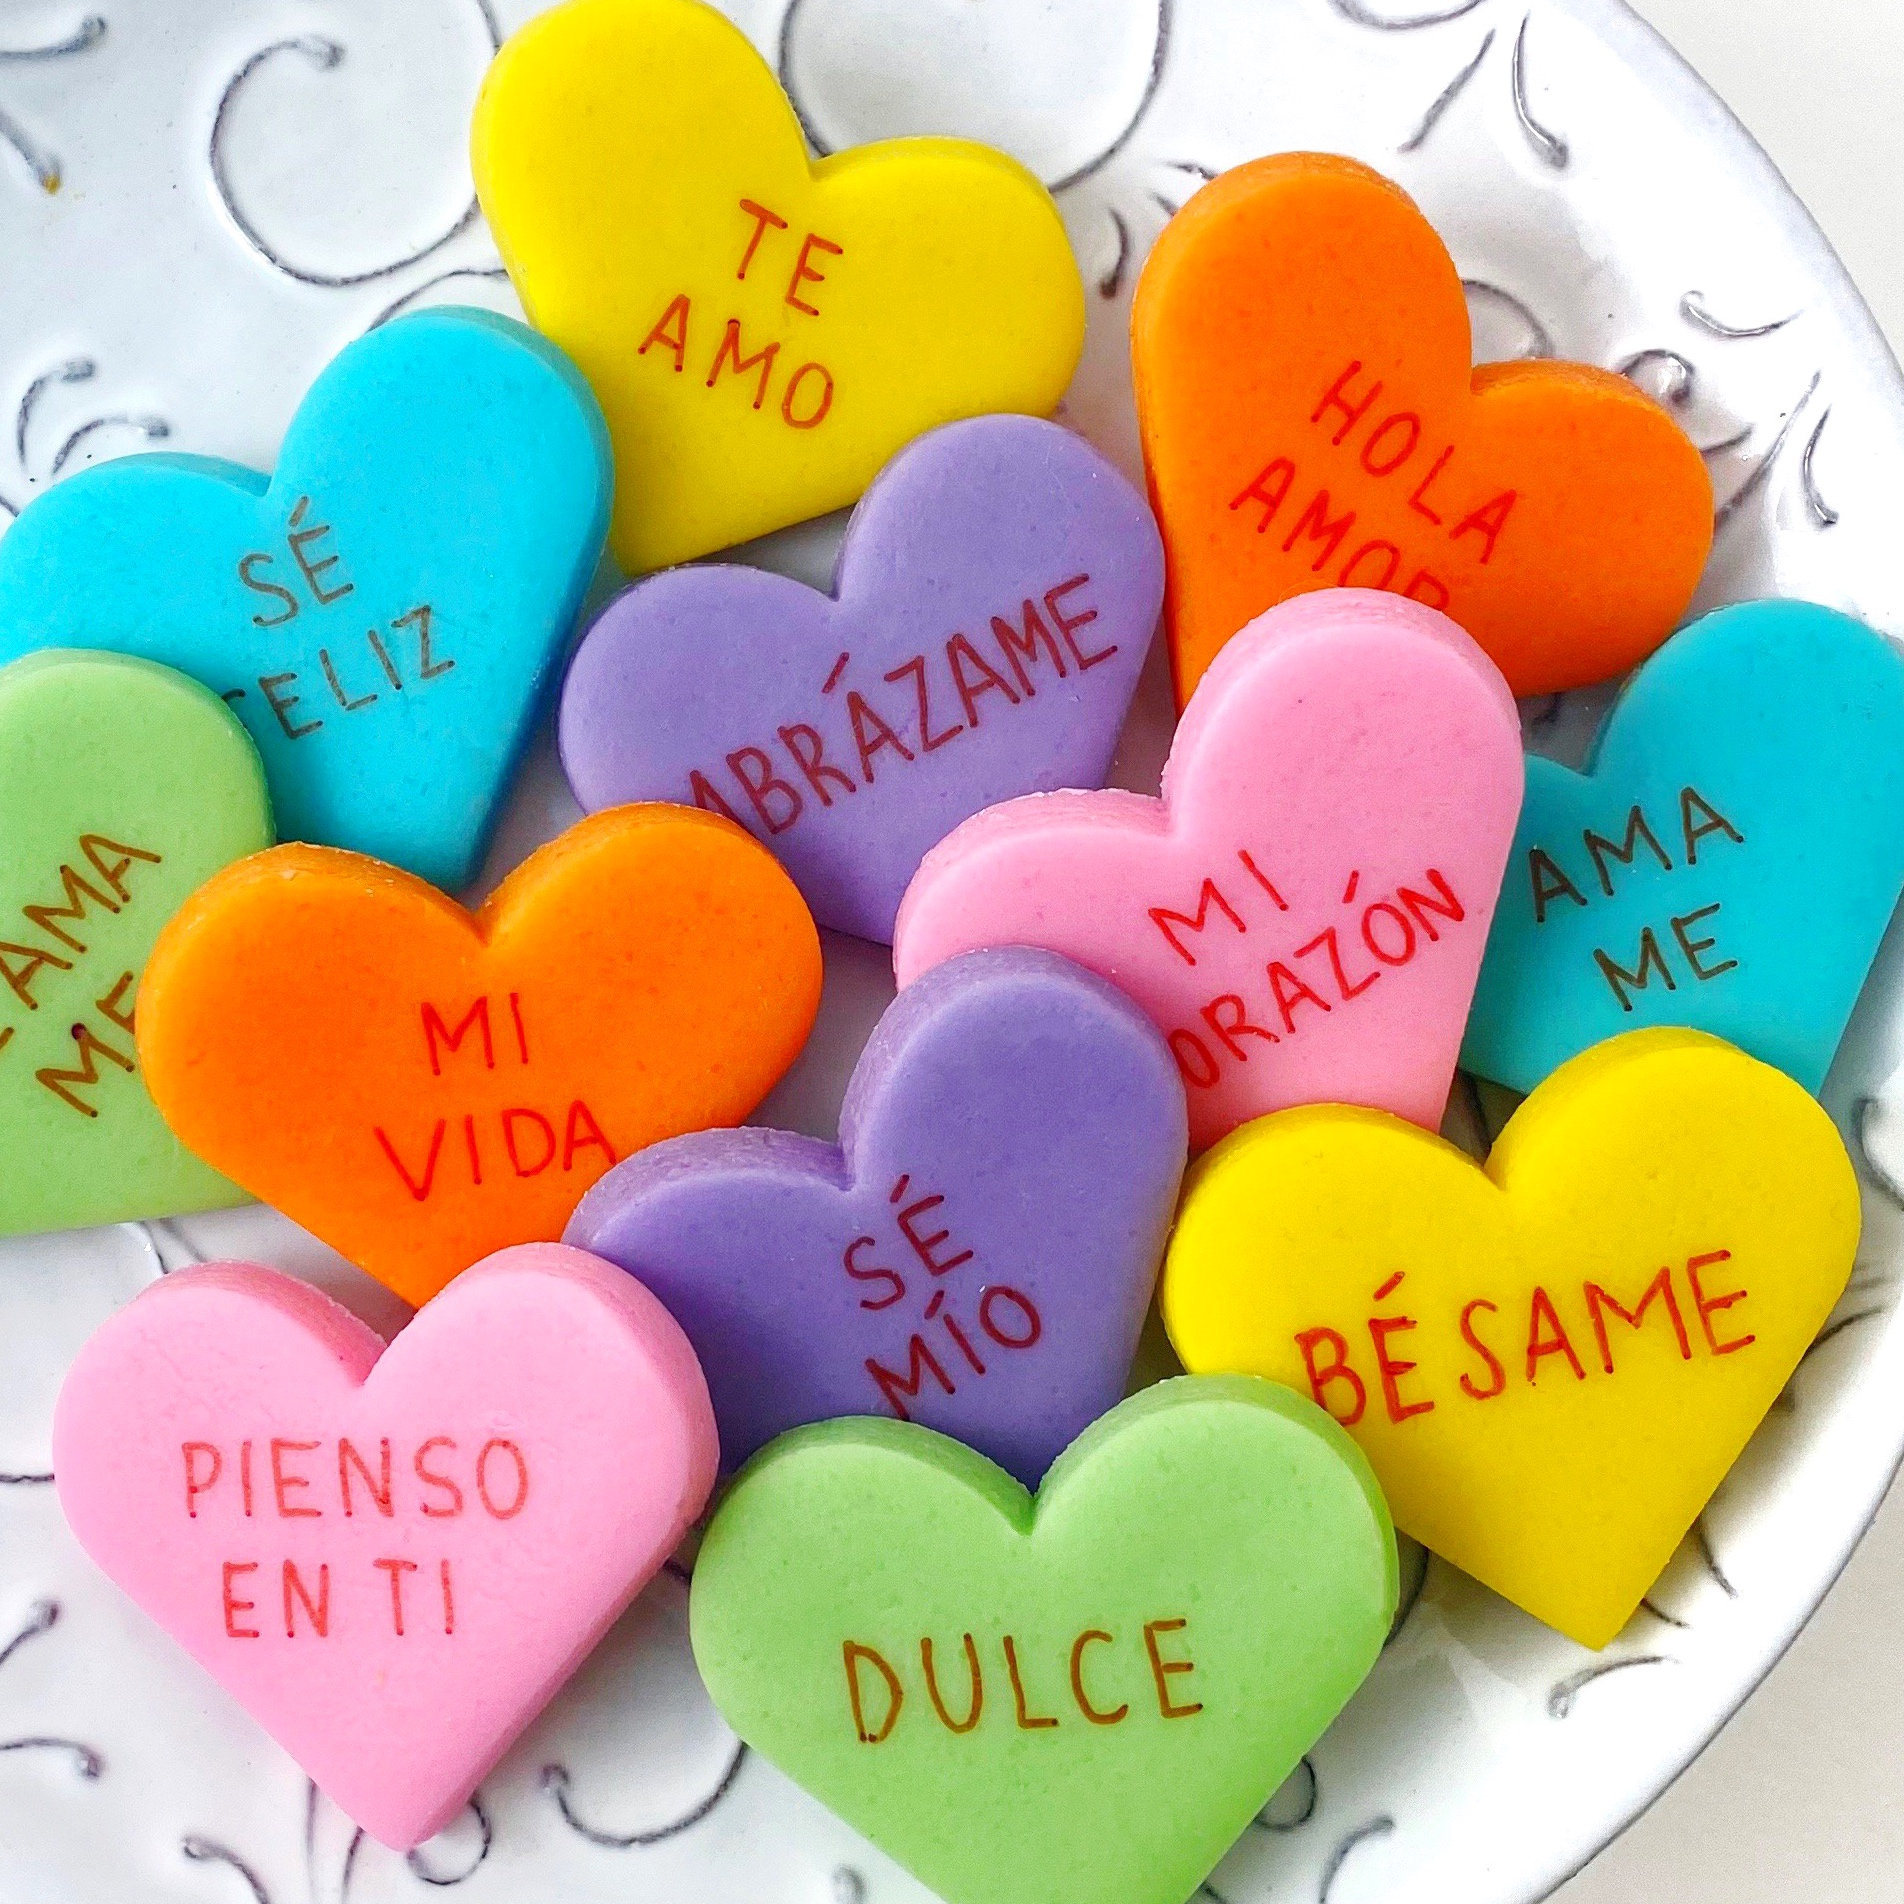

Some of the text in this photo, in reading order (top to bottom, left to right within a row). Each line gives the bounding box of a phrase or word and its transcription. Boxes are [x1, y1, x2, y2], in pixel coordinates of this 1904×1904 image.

[739, 199, 843, 315] TE
[638, 294, 834, 429] AMO
[1310, 360, 1519, 564] HOLA
[238, 496, 354, 627] SÉ
[222, 604, 455, 740] ELIZ
[1149, 849, 1288, 965] MI
[1529, 787, 1744, 923] AMA
[1167, 869, 1465, 1088] ORAZÓN
[1594, 903, 1738, 1011] ME
[421, 992, 528, 1076] MI
[373, 1100, 617, 1201] VIDA
[844, 1174, 974, 1310] SÉ
[865, 1286, 1041, 1421] MÍO
[1293, 1250, 1755, 1426] BÉSAME
[181, 1437, 529, 1520] PIENSO
[222, 1559, 456, 1638] EN TI
[843, 1618, 1203, 1743] DULCE
